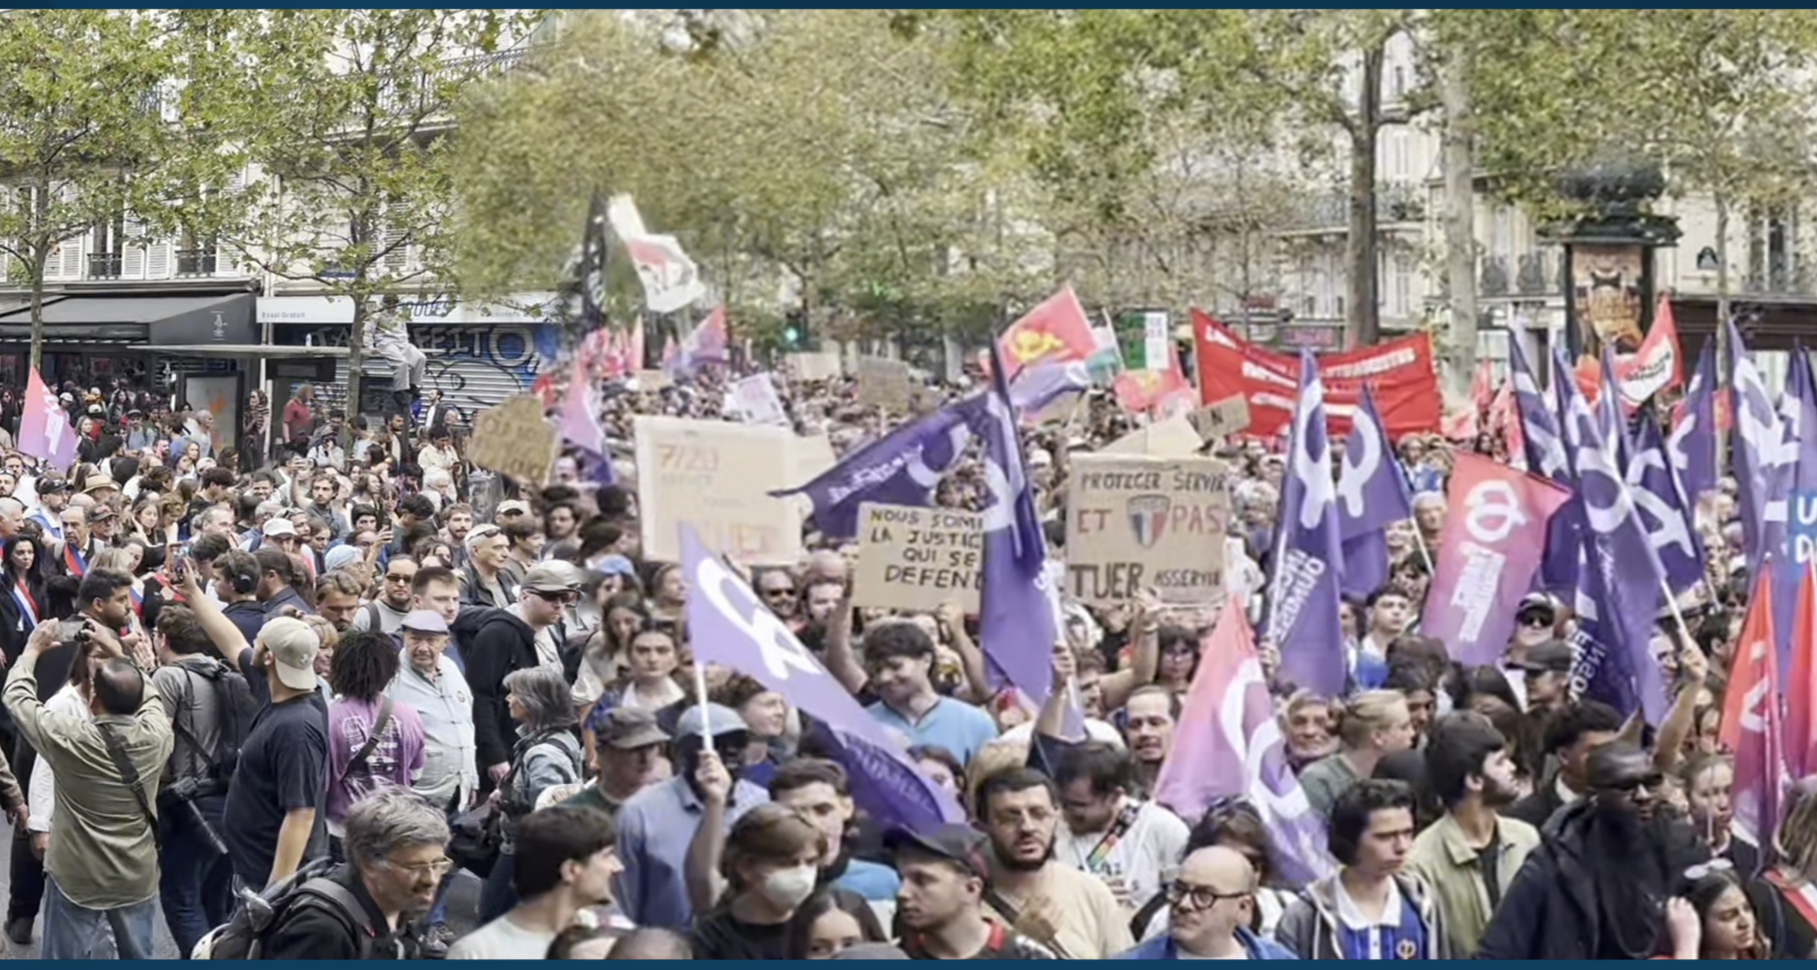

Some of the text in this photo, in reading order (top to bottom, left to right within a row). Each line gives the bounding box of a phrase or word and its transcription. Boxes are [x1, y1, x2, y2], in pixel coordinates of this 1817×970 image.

[870, 509, 984, 530] NOUS SOM
[1077, 504, 1226, 535] ET PAS
[871, 527, 892, 543] LA
[903, 547, 977, 567] QUI SE
[1069, 561, 1144, 600] TUER
